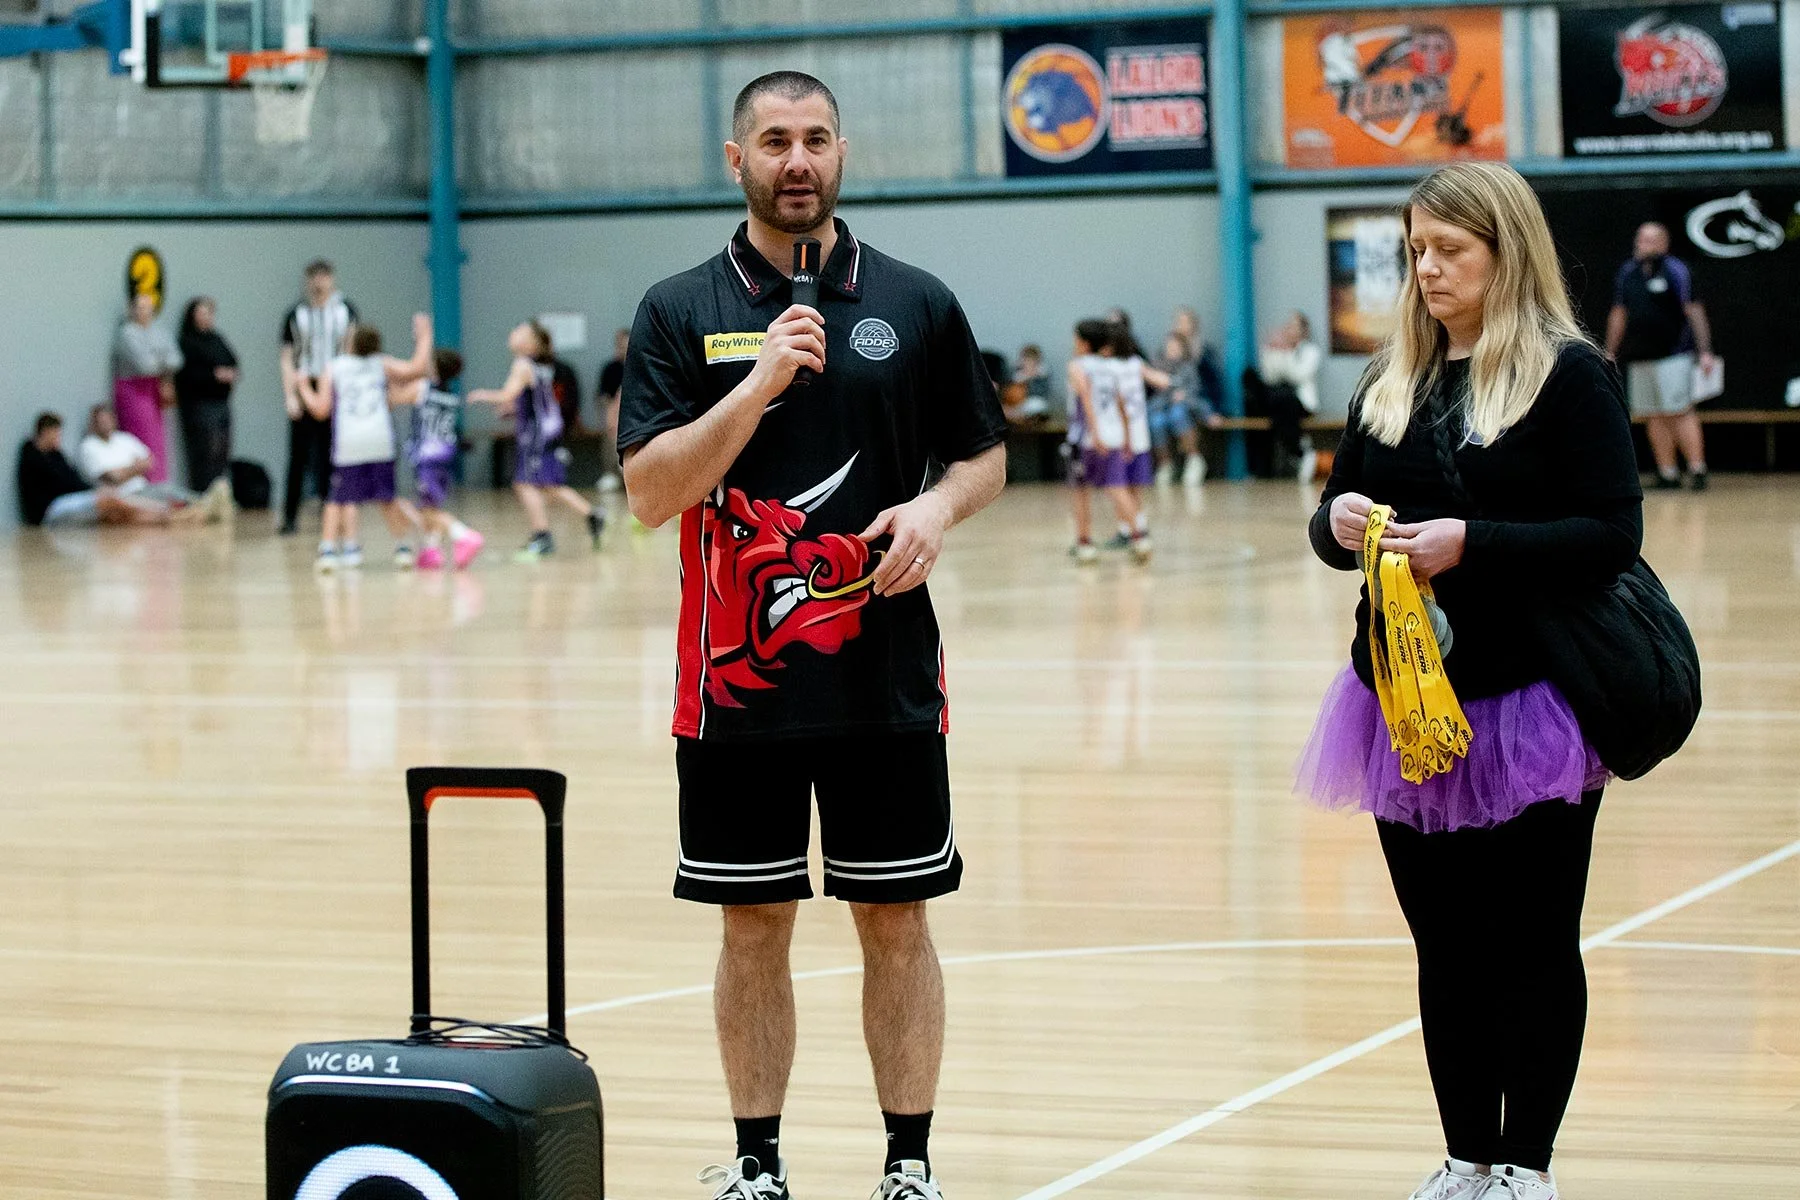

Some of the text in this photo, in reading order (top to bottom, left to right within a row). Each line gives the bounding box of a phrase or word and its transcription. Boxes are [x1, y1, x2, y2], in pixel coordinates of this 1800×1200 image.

[1109, 98, 1207, 142] LIONS
[793, 274, 810, 283] WCBA
[1395, 626, 1408, 665] PACERS
[1414, 637, 1428, 675] PACERS
[306, 1051, 400, 1074] WCBA 1
